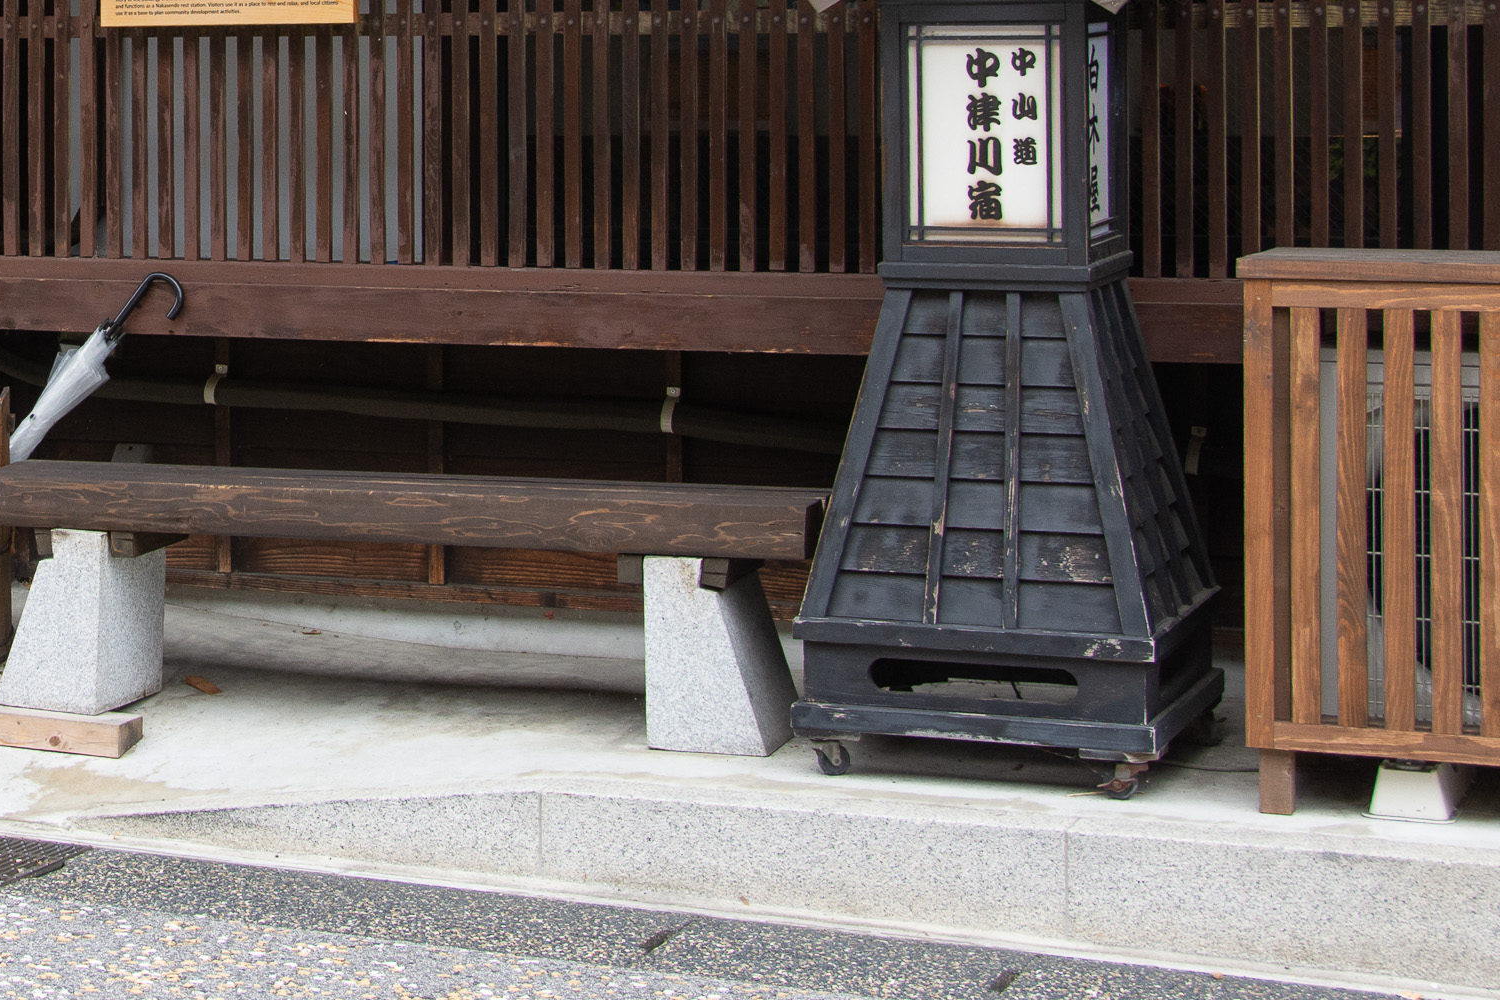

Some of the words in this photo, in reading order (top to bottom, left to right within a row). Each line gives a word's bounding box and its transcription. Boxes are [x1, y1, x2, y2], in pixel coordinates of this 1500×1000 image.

[965, 47, 1003, 221] 中津川宿
[1010, 47, 1039, 166] 中山道
